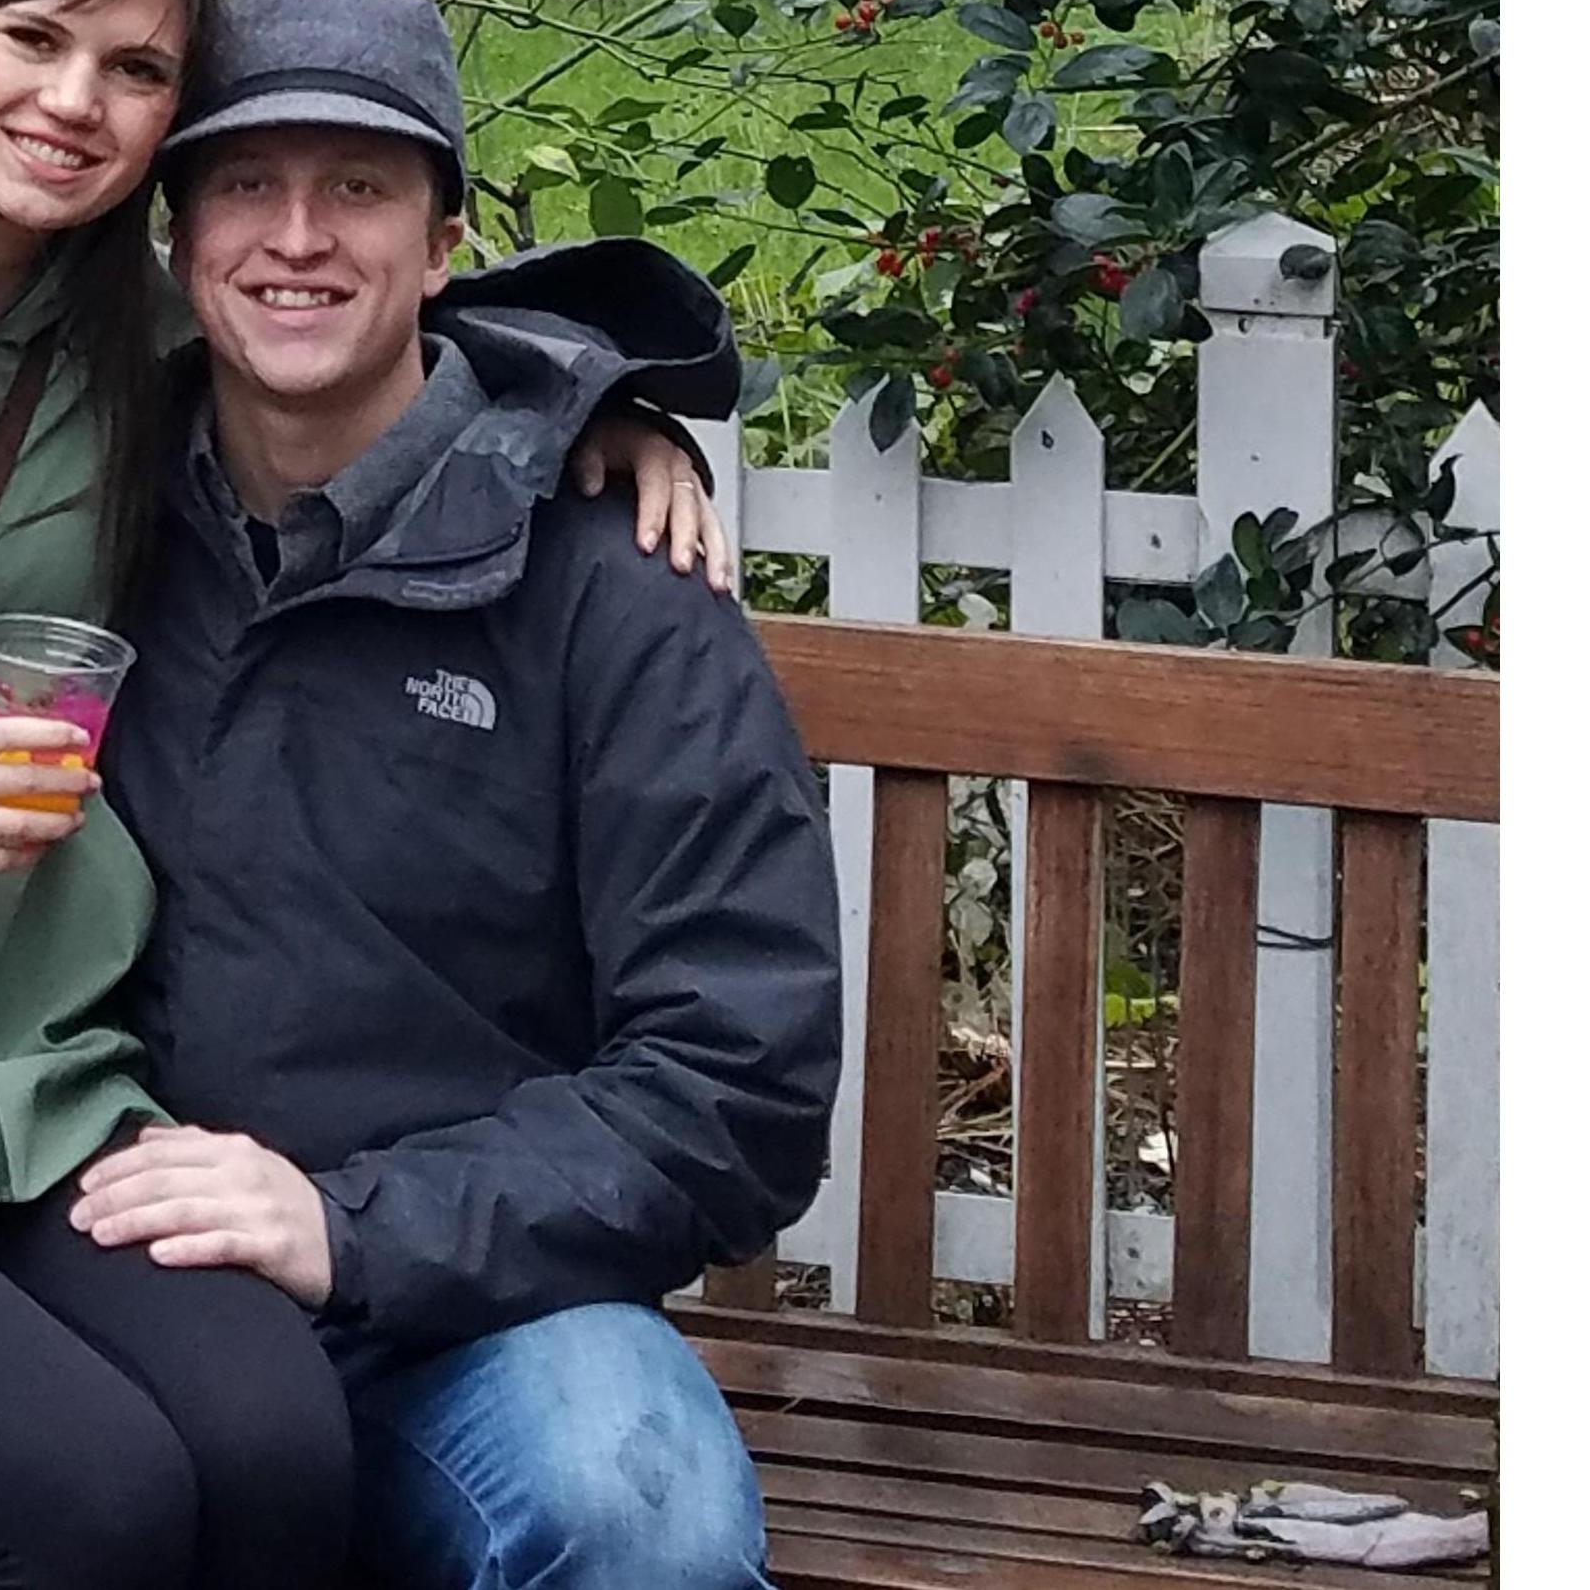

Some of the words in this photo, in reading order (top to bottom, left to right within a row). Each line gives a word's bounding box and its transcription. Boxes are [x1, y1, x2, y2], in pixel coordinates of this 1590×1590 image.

[405, 676, 464, 707] NORTH
[436, 668, 469, 693] THE
[418, 697, 464, 722] FACE
